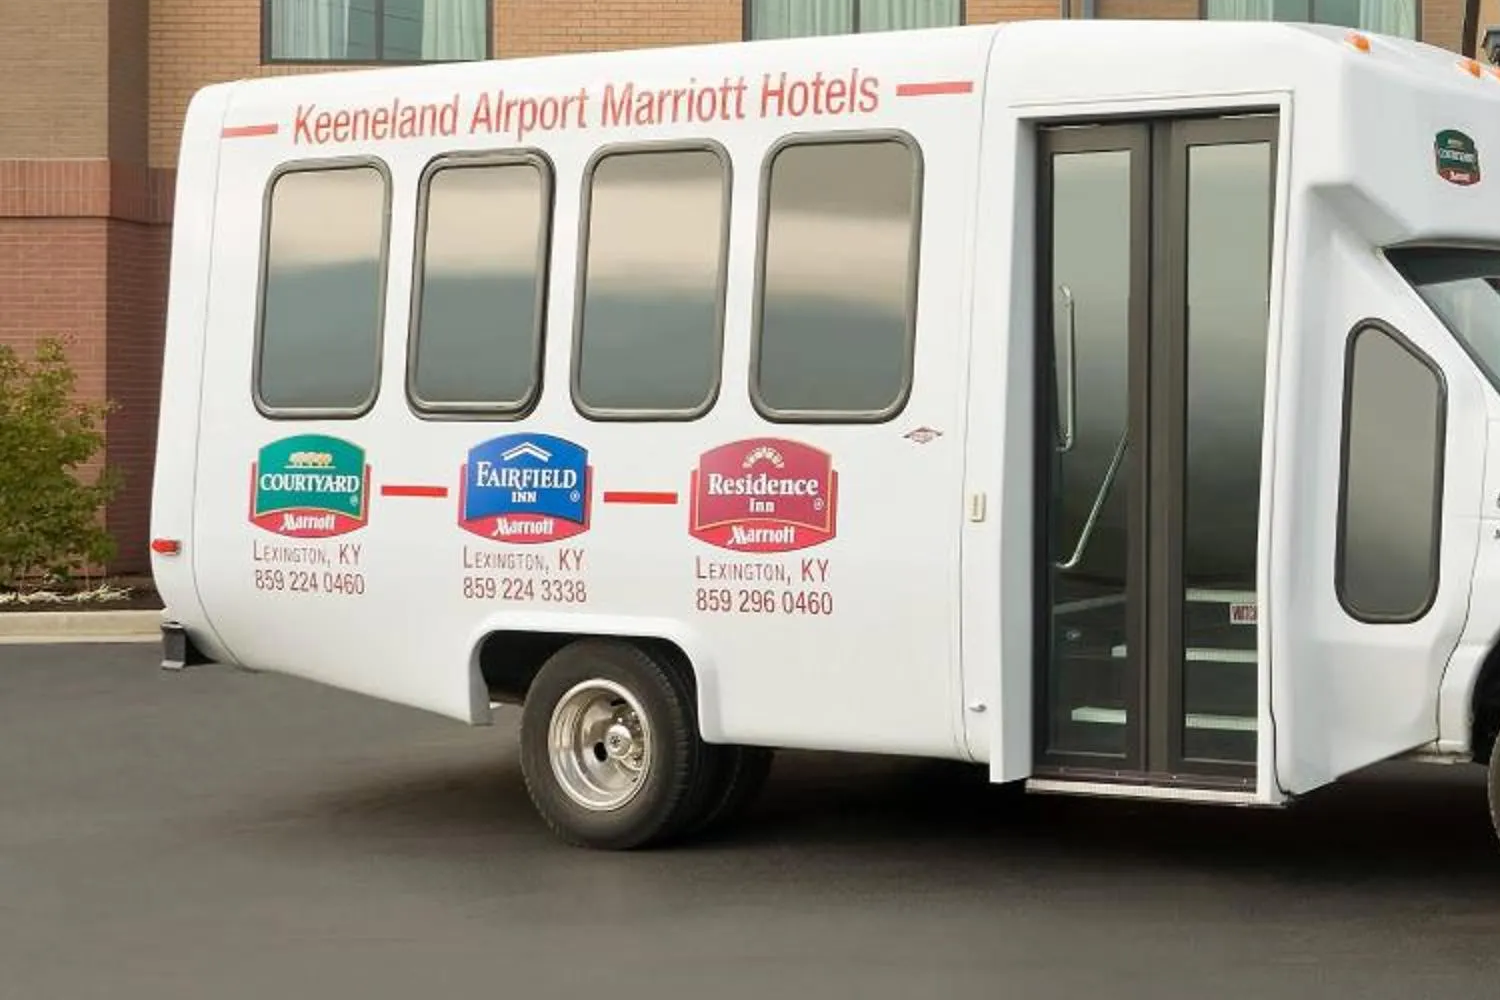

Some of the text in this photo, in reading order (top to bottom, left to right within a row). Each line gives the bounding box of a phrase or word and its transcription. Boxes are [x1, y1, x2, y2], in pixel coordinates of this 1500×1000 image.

[293, 93, 460, 146] Keeneland
[600, 76, 748, 129] Marriott
[760, 67, 880, 119] Hotels
[260, 473, 361, 494] COURTYARD
[475, 460, 578, 491] FAIRFIELD
[708, 472, 820, 496] Residence
[511, 490, 537, 503] INN
[749, 498, 776, 514] Inn
[279, 512, 336, 533] Marriott
[491, 516, 554, 538] Marriott
[727, 525, 796, 546] Marriott
[338, 542, 362, 566] KY
[558, 549, 585, 572] KY
[255, 569, 365, 596] 859 224 0460
[800, 559, 830, 583] KY
[463, 577, 588, 603] 859 224 3338
[695, 588, 834, 616] 859 296 0460
